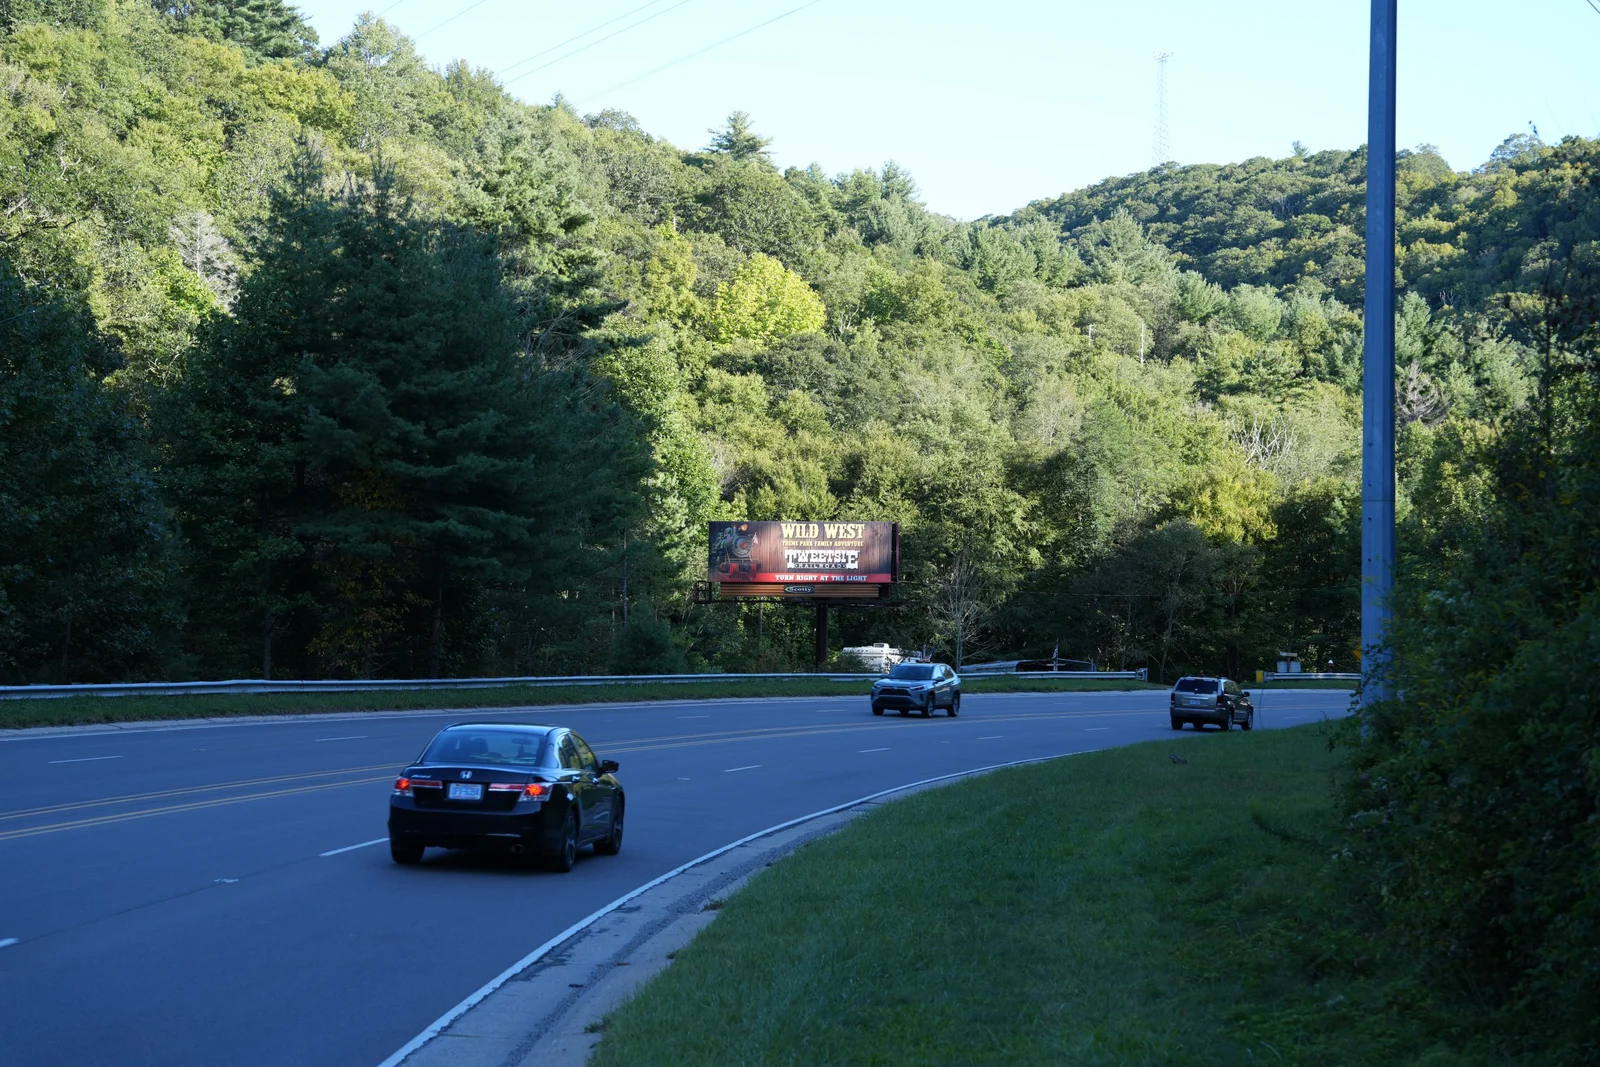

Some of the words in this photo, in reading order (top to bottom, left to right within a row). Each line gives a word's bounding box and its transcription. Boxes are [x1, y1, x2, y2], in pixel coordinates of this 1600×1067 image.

[781, 523, 819, 539] WILD
[824, 523, 865, 539] WEST
[785, 549, 860, 569] TWEETSIE
